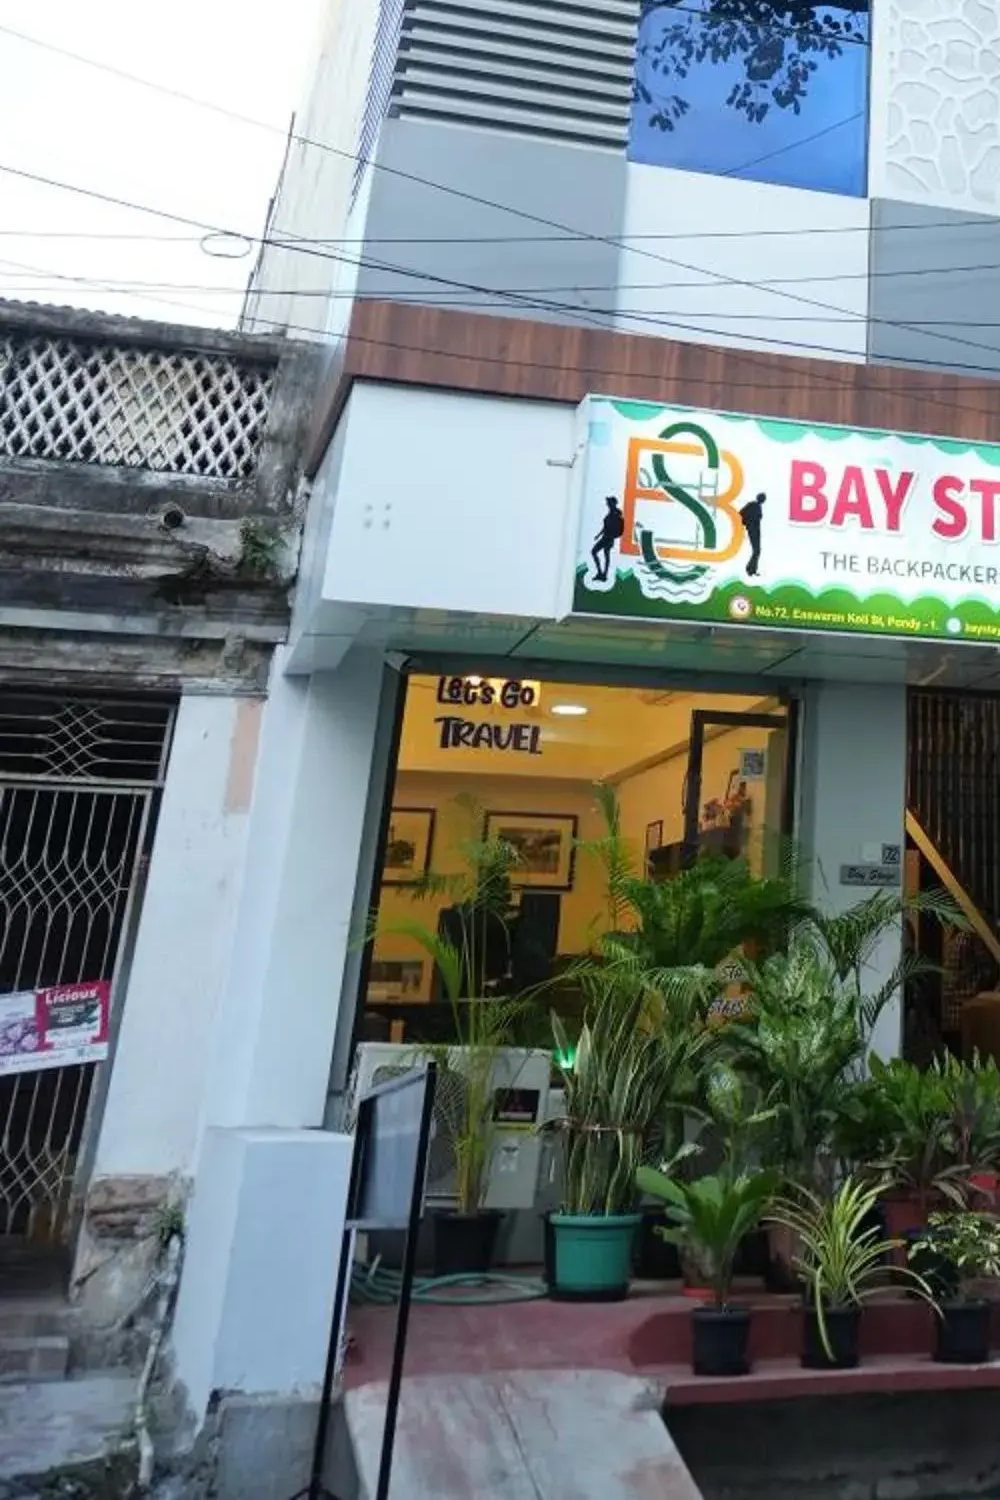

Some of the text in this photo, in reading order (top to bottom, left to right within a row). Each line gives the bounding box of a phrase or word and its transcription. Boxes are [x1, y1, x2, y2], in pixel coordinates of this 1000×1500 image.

[789, 459, 914, 531] BAY
[819, 552, 860, 574] THE
[887, 616, 921, 631] Pondy
[500, 679, 534, 708] Go
[435, 716, 542, 755] TRAVEL
